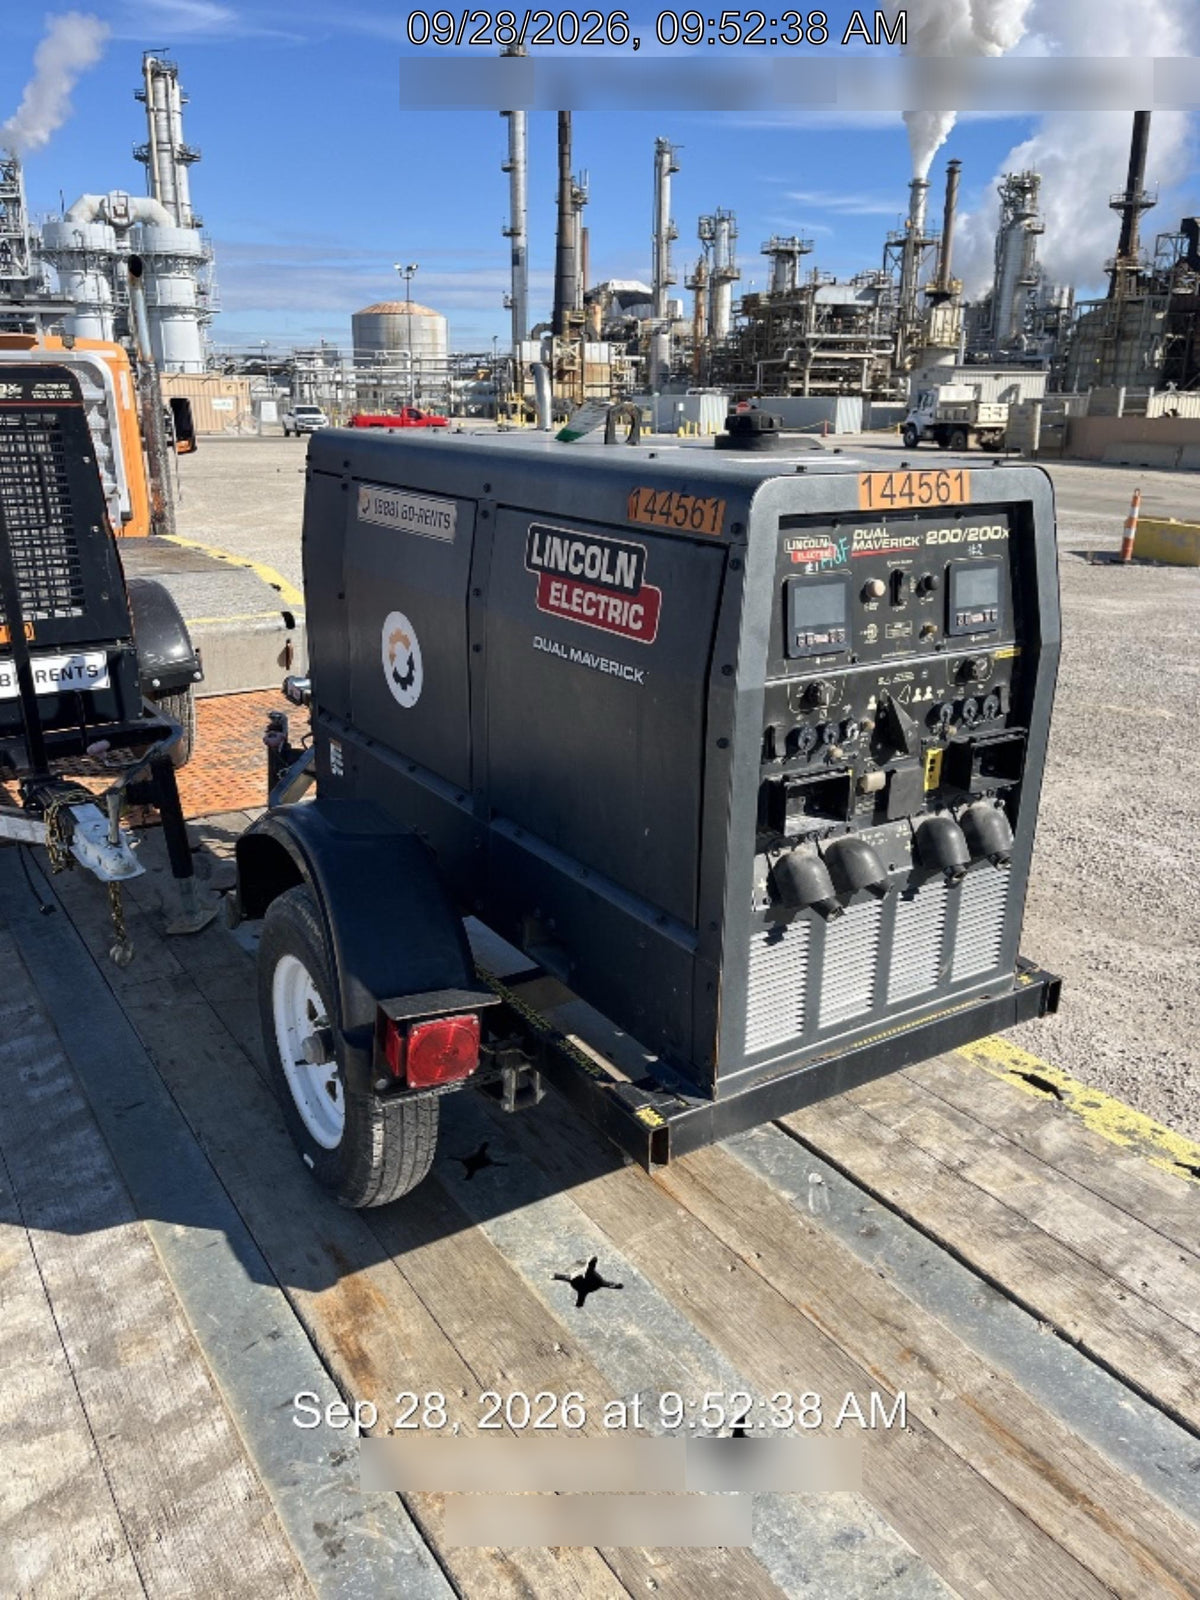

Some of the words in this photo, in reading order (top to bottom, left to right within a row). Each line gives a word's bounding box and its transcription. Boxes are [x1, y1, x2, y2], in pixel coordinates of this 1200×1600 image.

[862, 469, 964, 507] 144561
[631, 488, 721, 531] 144561
[787, 538, 829, 550] LINCOLN
[851, 536, 920, 551] MAVERICK
[853, 527, 890, 540] DUAL
[531, 532, 638, 589] LINCOLN
[549, 581, 645, 630] ELECTRIC
[533, 635, 568, 659] DUAL
[569, 648, 645, 685] MAVERICK
